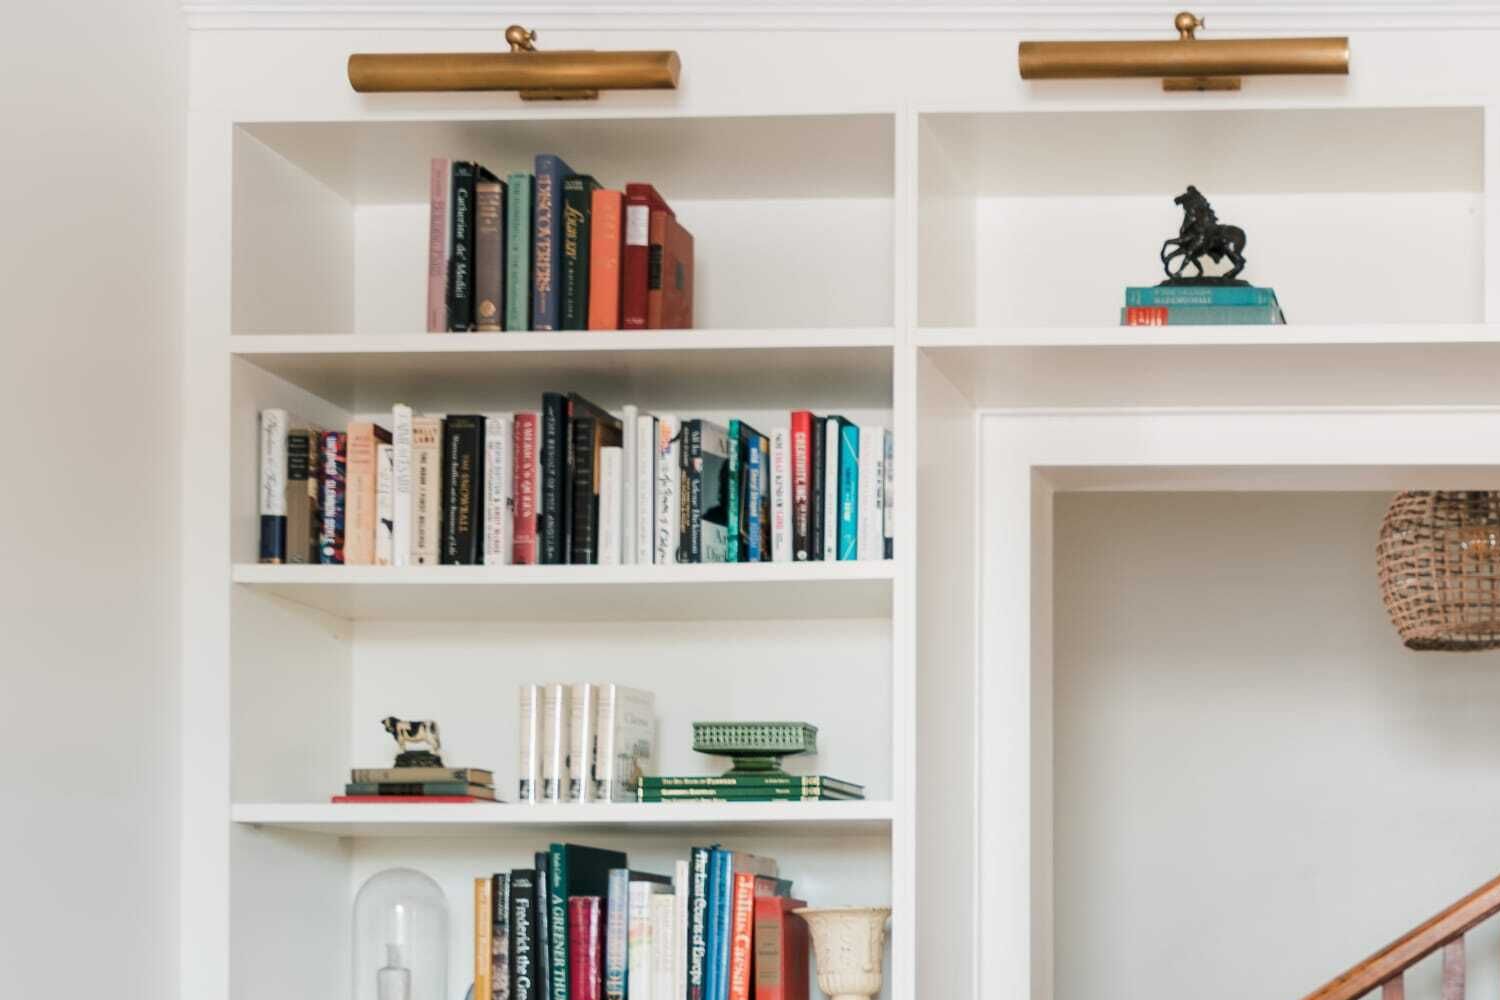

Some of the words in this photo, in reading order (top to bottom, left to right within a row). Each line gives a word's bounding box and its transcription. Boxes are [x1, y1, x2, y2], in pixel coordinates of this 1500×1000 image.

[455, 188, 469, 239] Catherine
[455, 263, 469, 299] Medici
[324, 436, 337, 476] UNTAMED
[324, 479, 337, 517] GLENNON
[691, 509, 700, 555] Dickinson
[694, 850, 708, 872] The
[552, 894, 563, 905] A
[694, 873, 708, 897] Last
[736, 876, 753, 931] Julius
[515, 898, 531, 954] Frederick
[693, 898, 707, 933] Courts
[552, 906, 566, 967] GREENER
[516, 955, 530, 975] the
[689, 946, 706, 985] Europe
[733, 934, 751, 997] Caesar
